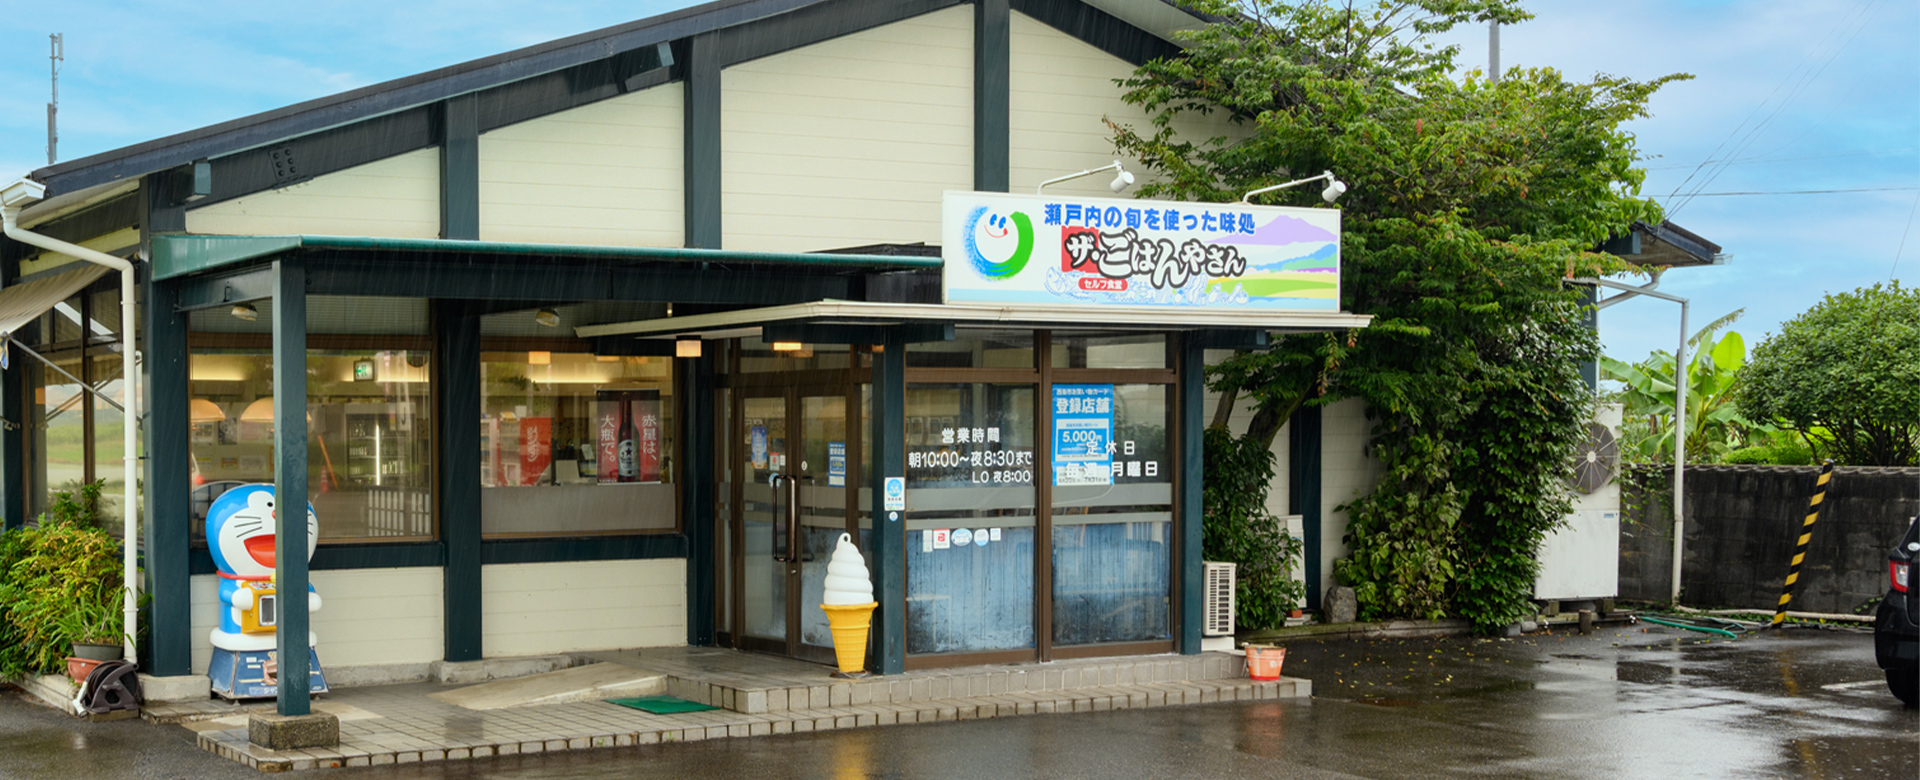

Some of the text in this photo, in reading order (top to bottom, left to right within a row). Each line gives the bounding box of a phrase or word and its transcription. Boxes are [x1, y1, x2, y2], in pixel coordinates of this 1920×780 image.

[1044, 203, 1256, 235] 瀬戸内の旬を使った味処
[1084, 279, 1123, 290] セルフ食堂
[1056, 397, 1110, 414] 登録店舗
[601, 414, 615, 461] 大瓶で。
[642, 414, 657, 461] 赤星は、
[941, 427, 1000, 444] 営業時間
[1086, 440, 1135, 456] 定休日
[972, 471, 989, 484] LO
[993, 470, 1031, 483] 夜8:00
[1065, 461, 1098, 477] 毎週
[1110, 461, 1158, 478] 月曜日
